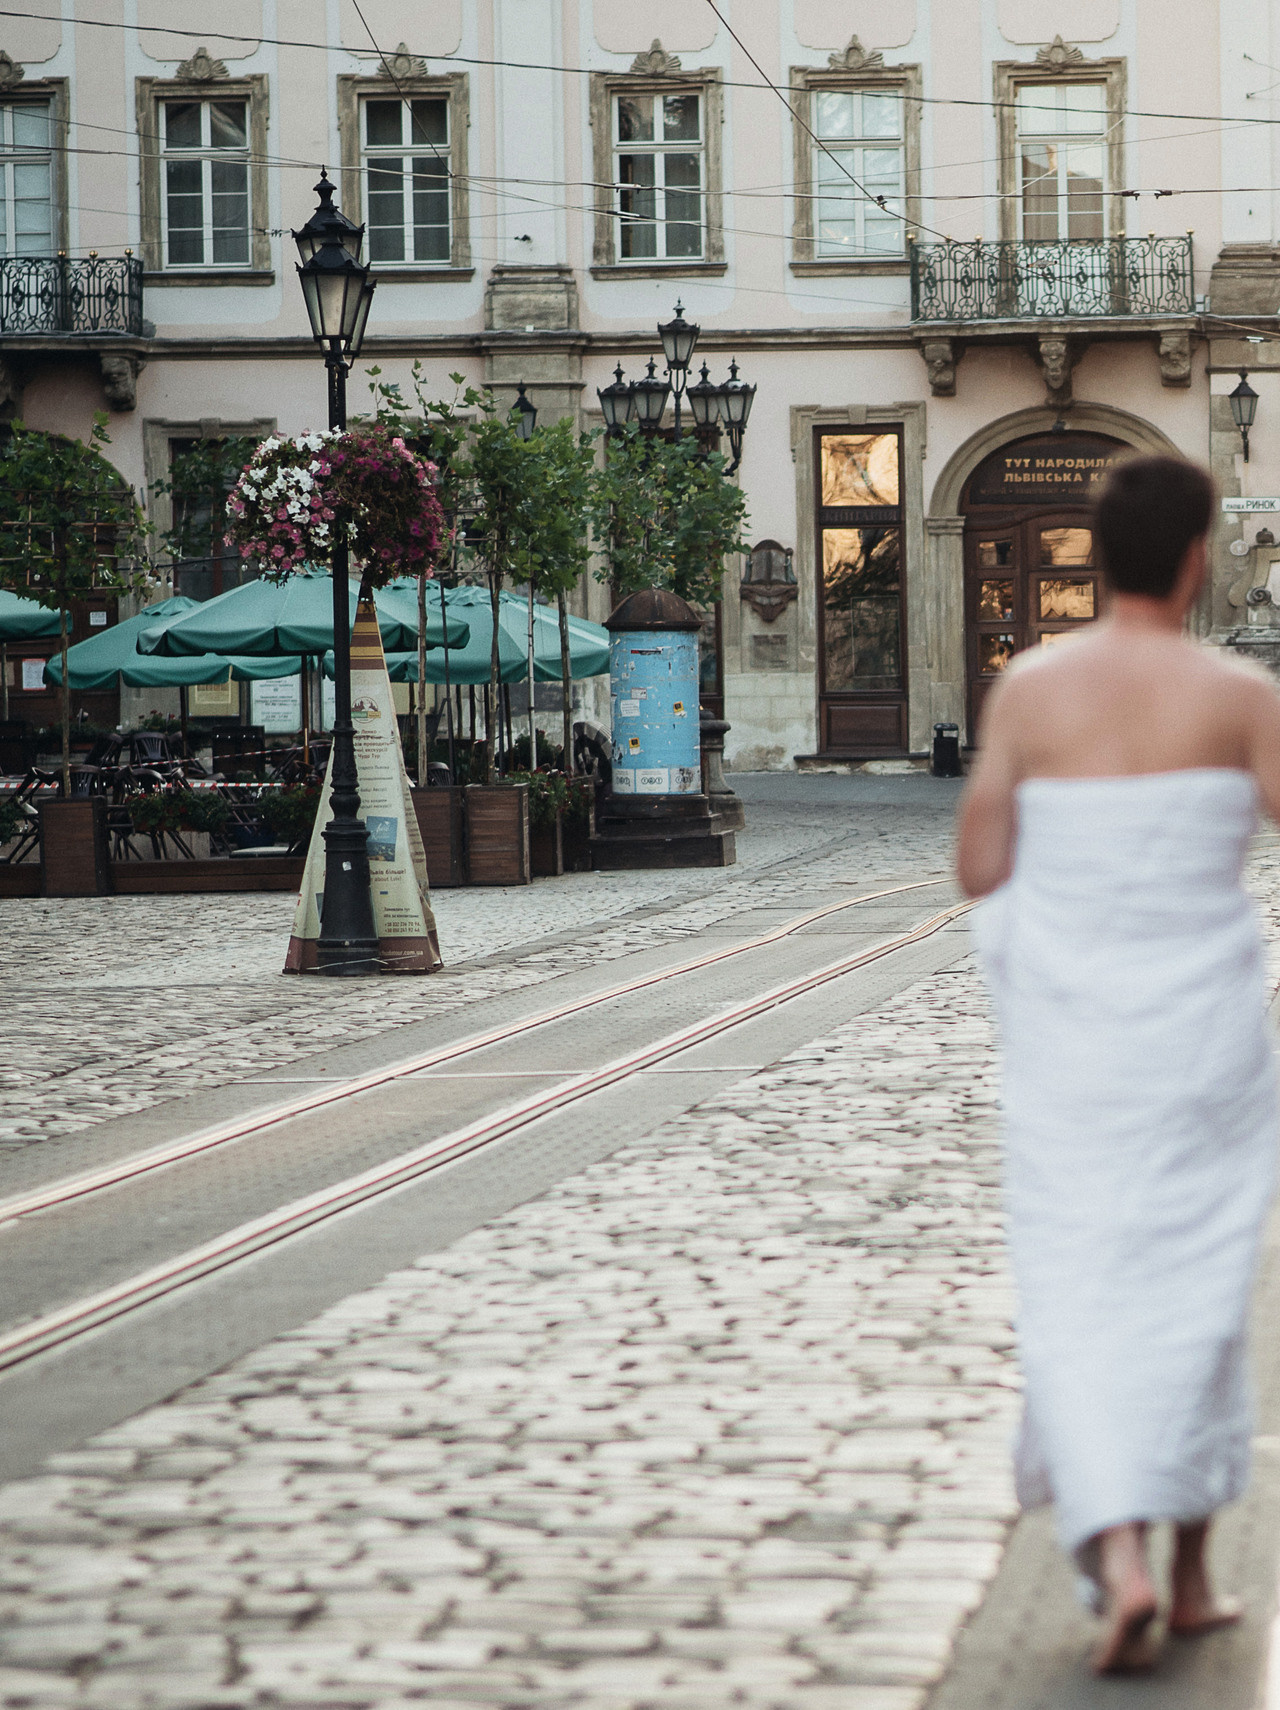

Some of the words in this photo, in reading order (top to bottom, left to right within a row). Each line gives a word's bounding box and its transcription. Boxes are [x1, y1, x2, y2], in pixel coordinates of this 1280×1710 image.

[1004, 458, 1031, 468] ТУТ
[1035, 458, 1122, 469] НАРОДИЛАС
[1003, 472, 1083, 482] ЛЬВІВСЬКА
[1246, 500, 1277, 510] РИНОК
